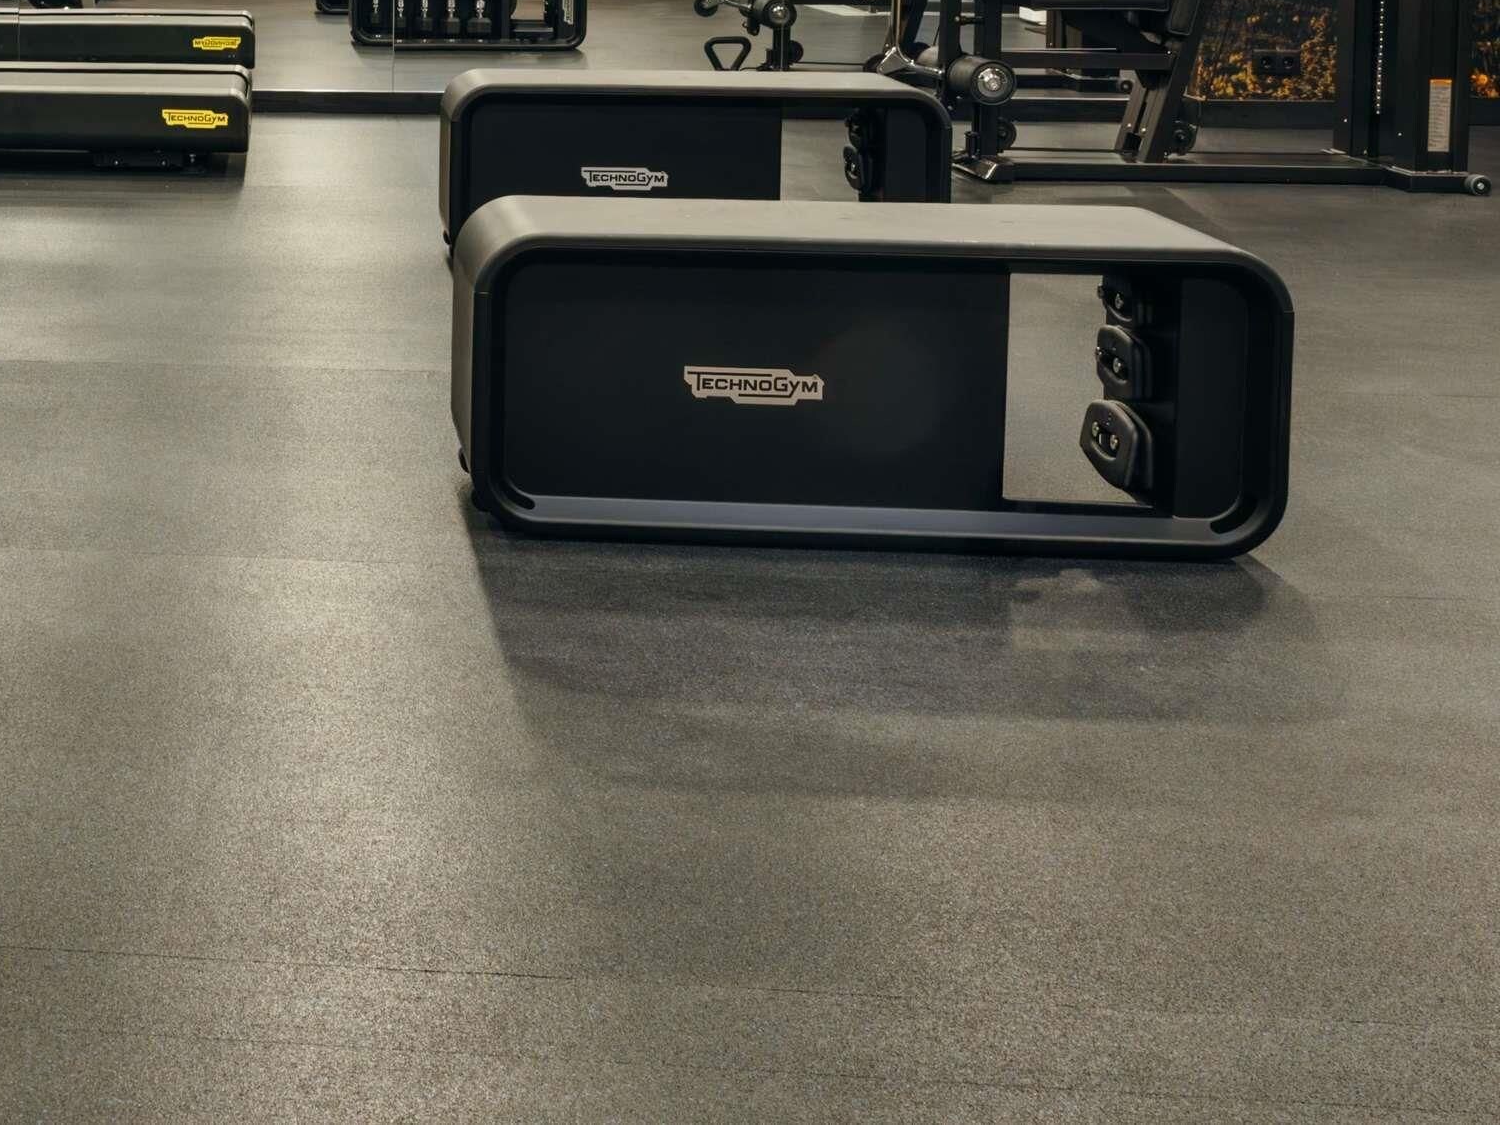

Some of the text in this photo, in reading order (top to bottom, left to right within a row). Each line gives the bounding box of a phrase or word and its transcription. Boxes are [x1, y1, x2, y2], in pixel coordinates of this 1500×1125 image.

[163, 111, 226, 125] TECHNOGYM
[583, 170, 665, 187] TECHNOGYM
[687, 371, 819, 399] TECHNOGYM
